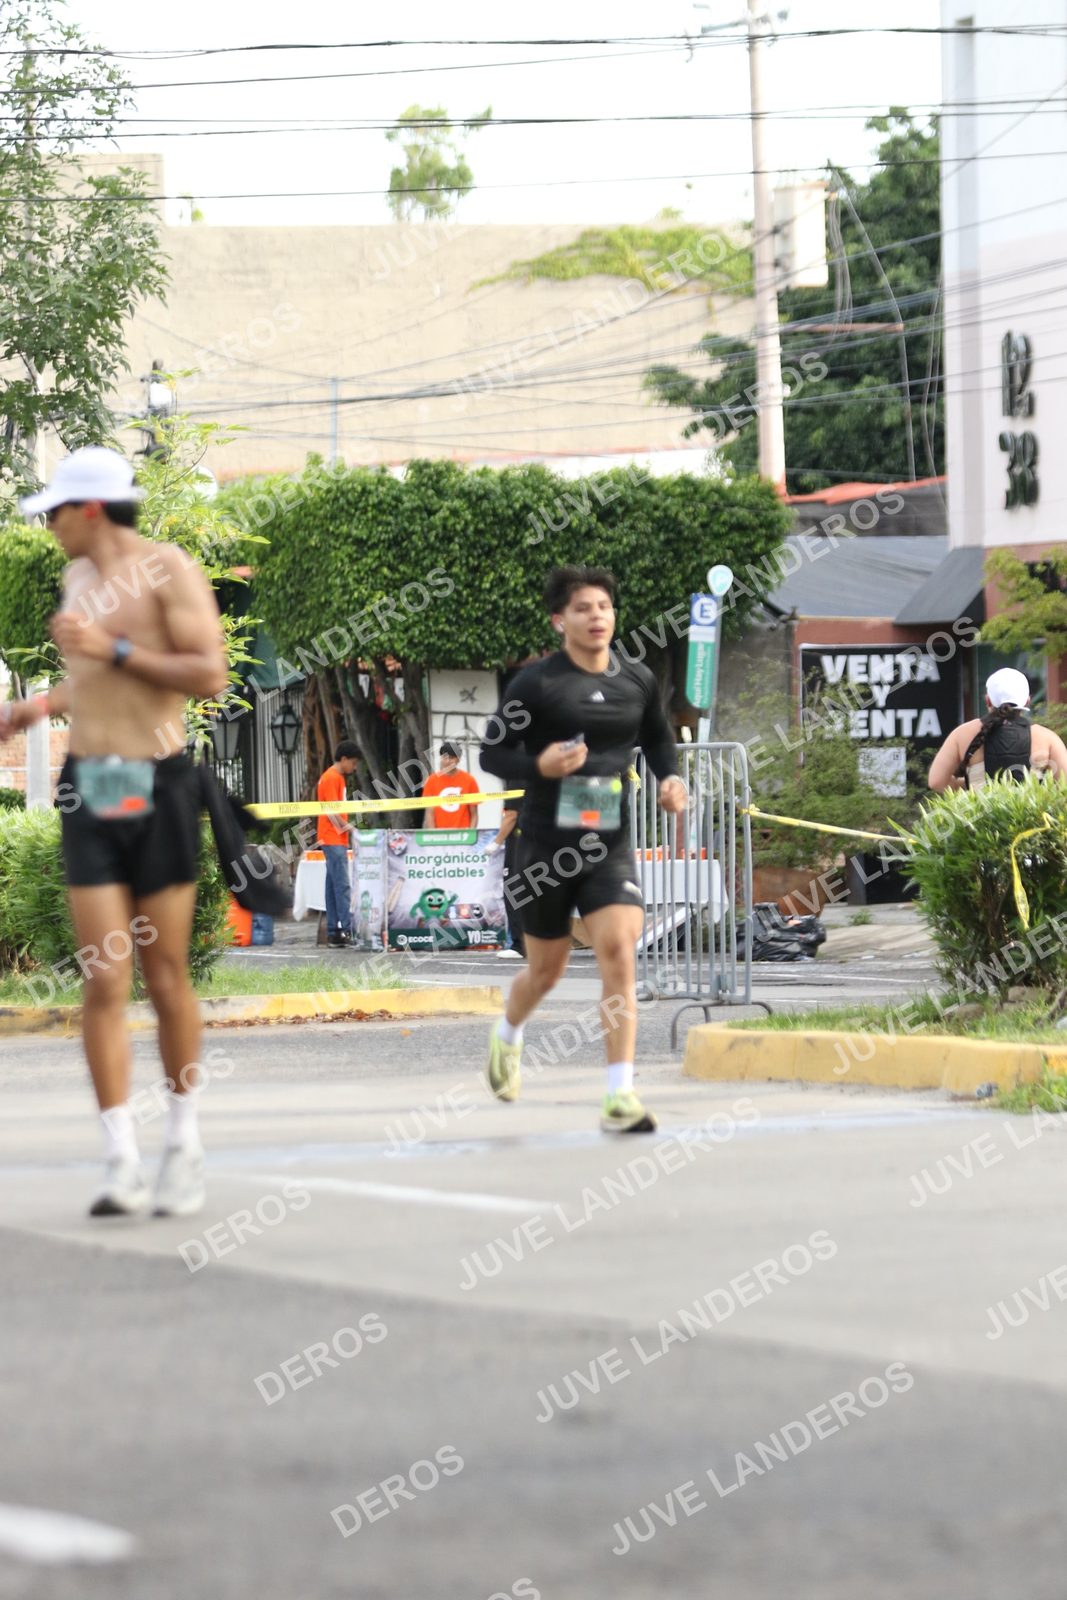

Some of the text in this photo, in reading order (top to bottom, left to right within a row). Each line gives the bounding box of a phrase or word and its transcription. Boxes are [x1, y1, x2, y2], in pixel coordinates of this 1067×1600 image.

[700, 603, 712, 618] E
[821, 654, 940, 683] VENTA
[872, 685, 890, 708] Y
[405, 853, 488, 866] Inorgánicos
[408, 867, 485, 879] Reciclables
